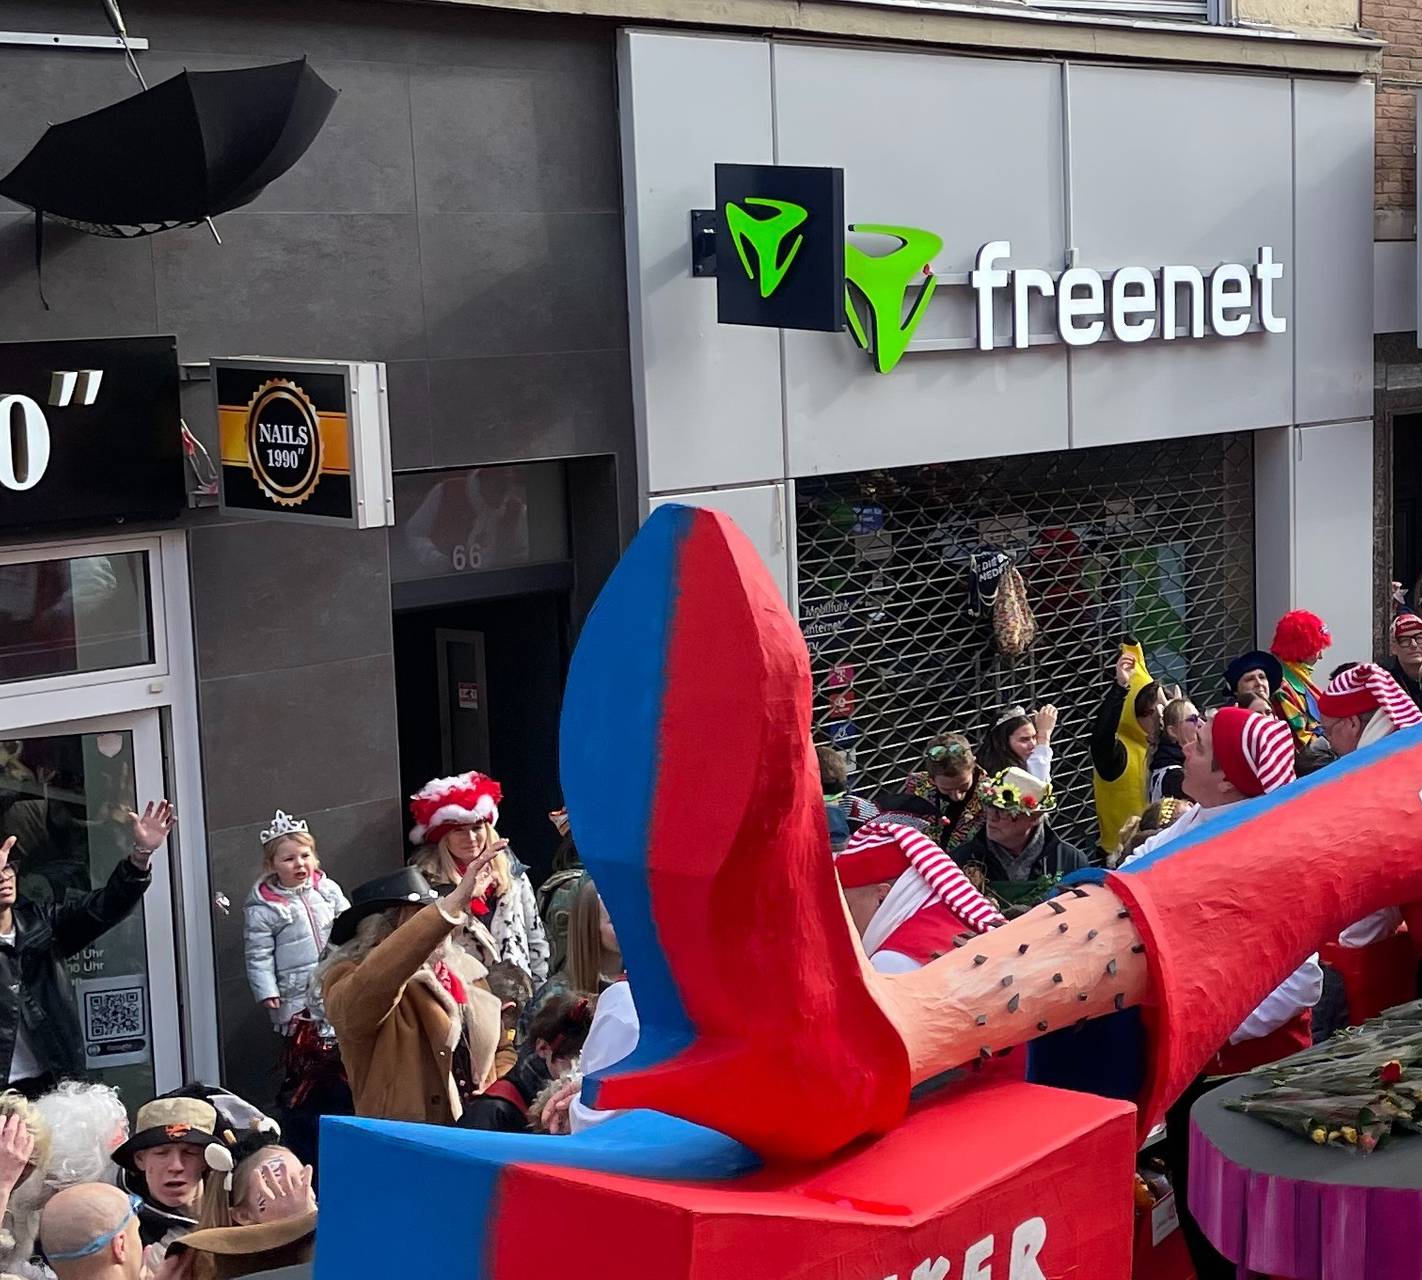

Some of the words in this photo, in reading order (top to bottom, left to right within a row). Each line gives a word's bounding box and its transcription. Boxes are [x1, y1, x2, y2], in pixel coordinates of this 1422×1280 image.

[970, 240, 1287, 350] freenet
[258, 423, 309, 446] NAILS
[453, 543, 482, 570] 66
[82, 949, 104, 959] Uhr
[83, 960, 104, 972] Uhr
